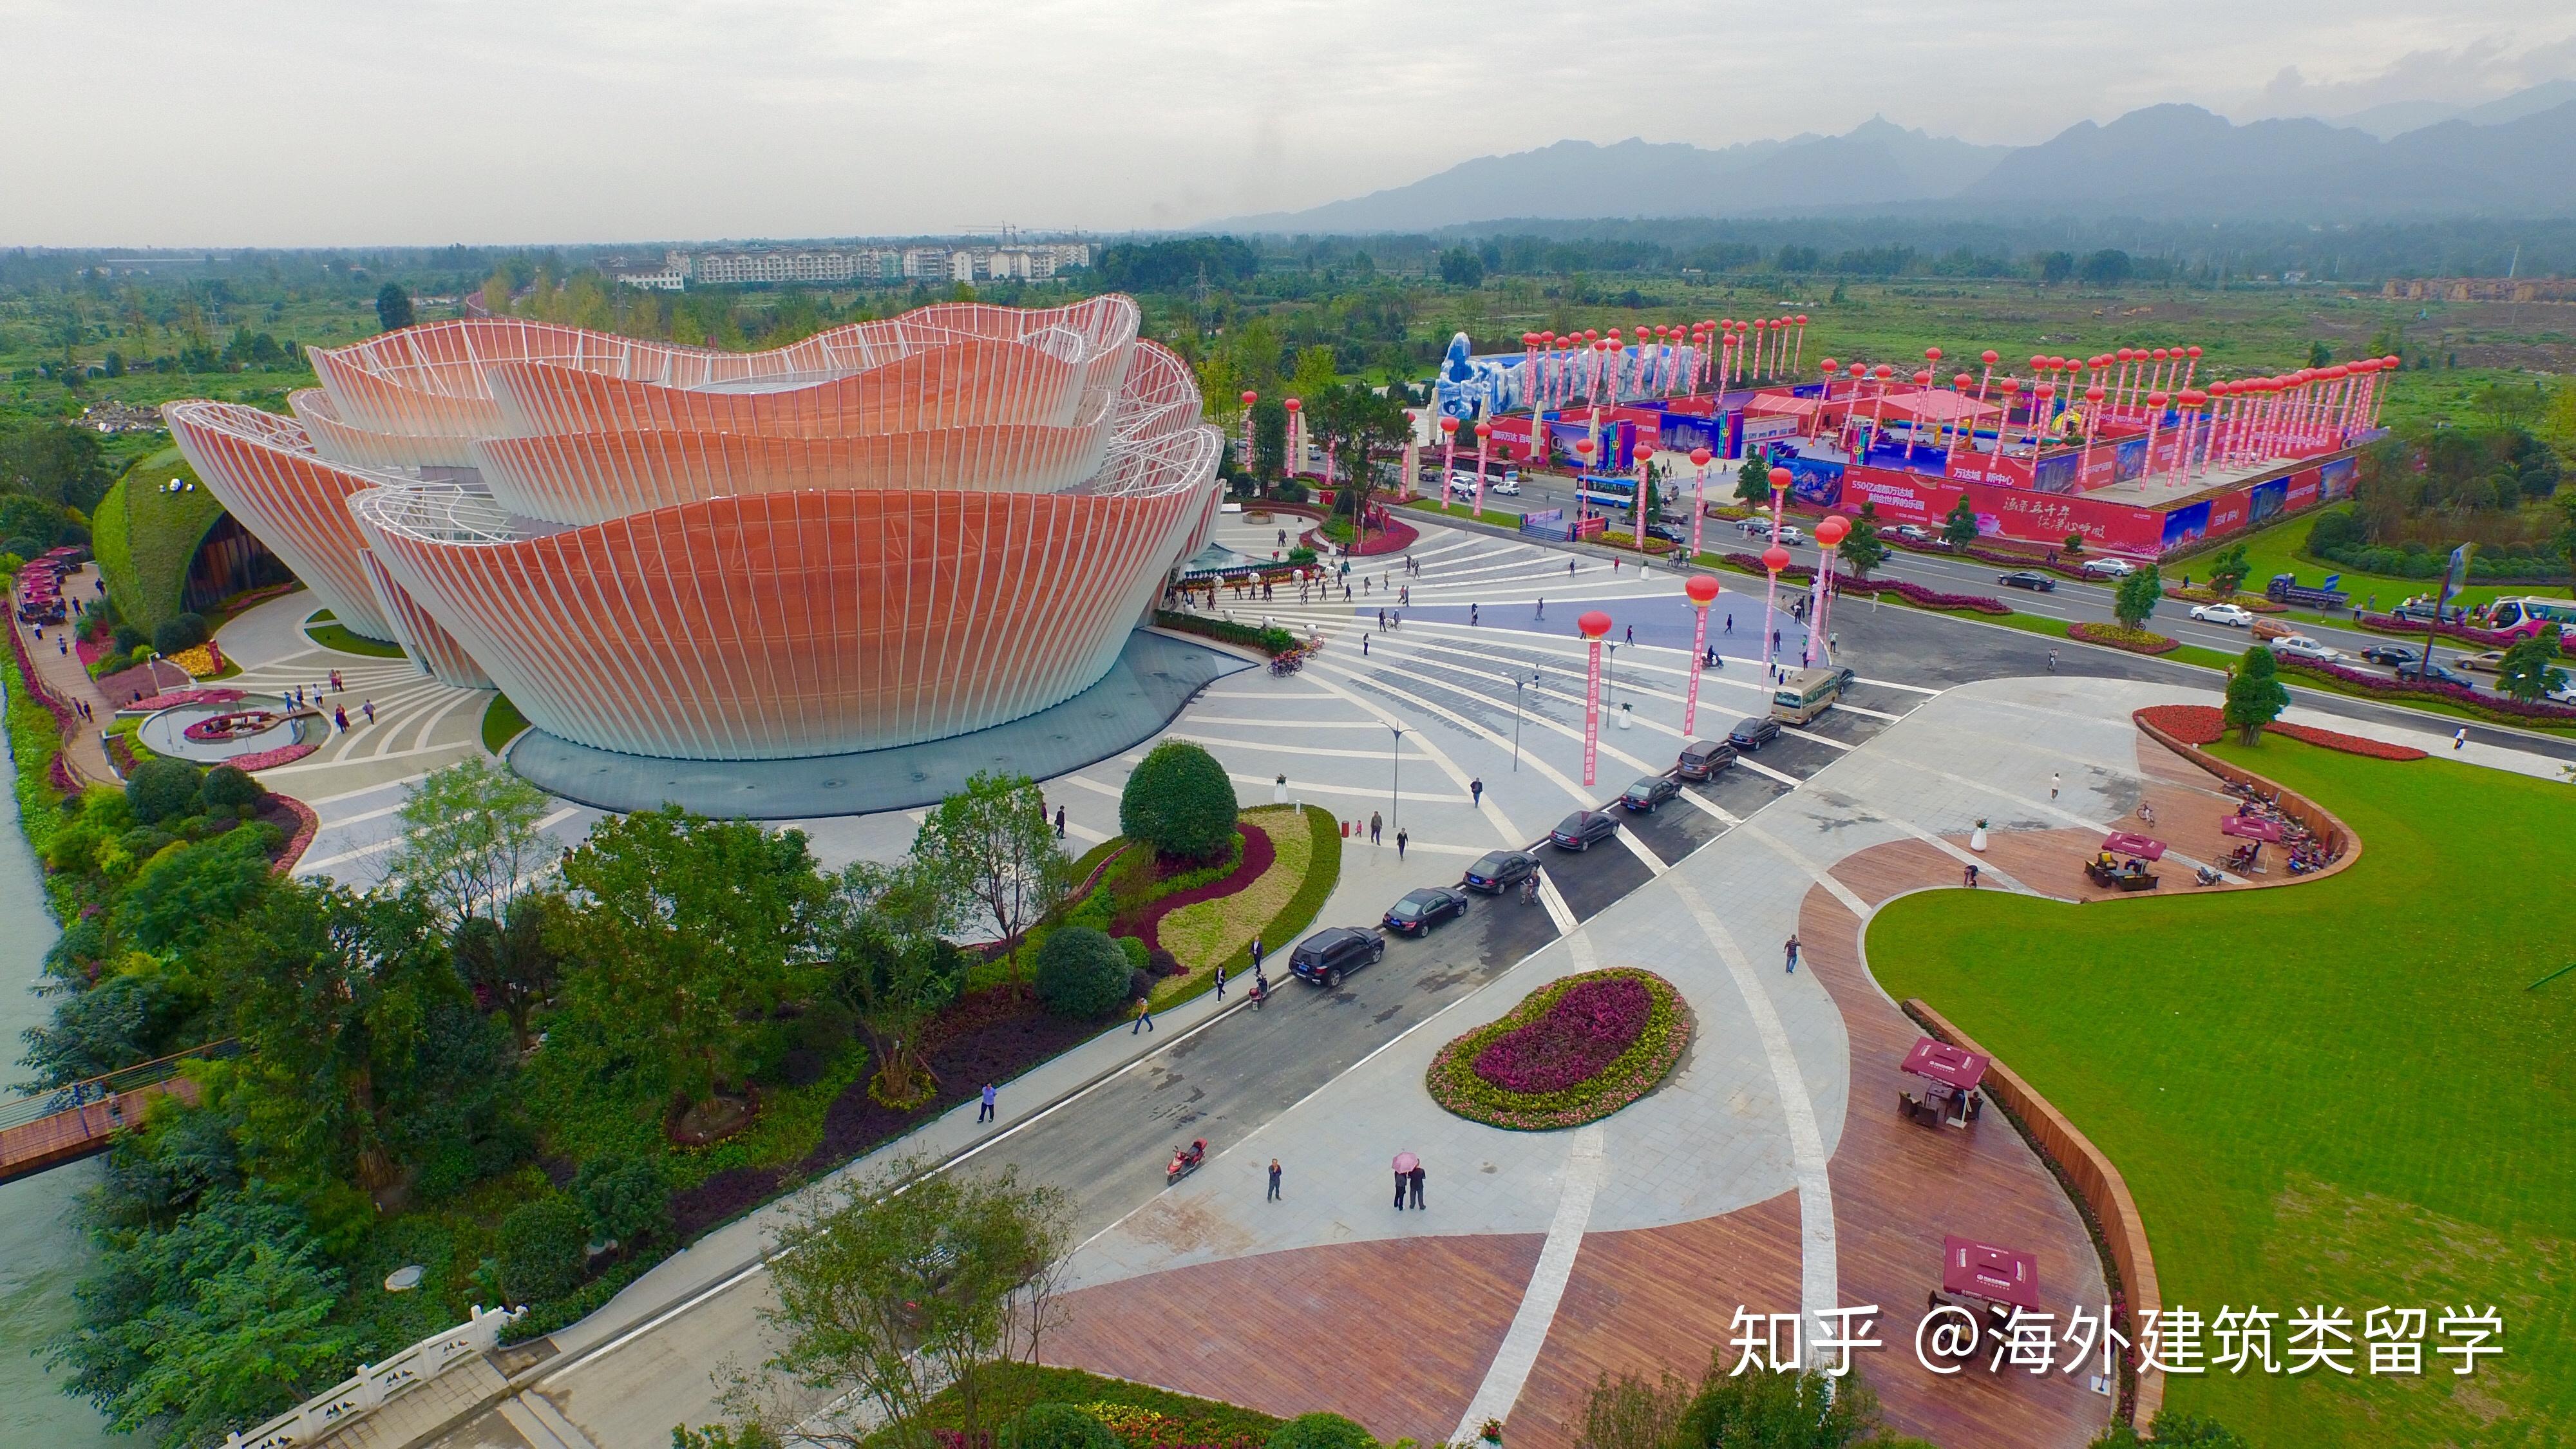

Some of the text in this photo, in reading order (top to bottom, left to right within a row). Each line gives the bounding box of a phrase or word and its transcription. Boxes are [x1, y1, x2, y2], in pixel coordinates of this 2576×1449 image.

[1519, 433, 1545, 446] 百年业
[1953, 468, 2014, 486] 万达城 新中心
[1852, 480, 1914, 498] 550亿成都万达城
[1589, 648, 1598, 714] 550亿成都万达城
